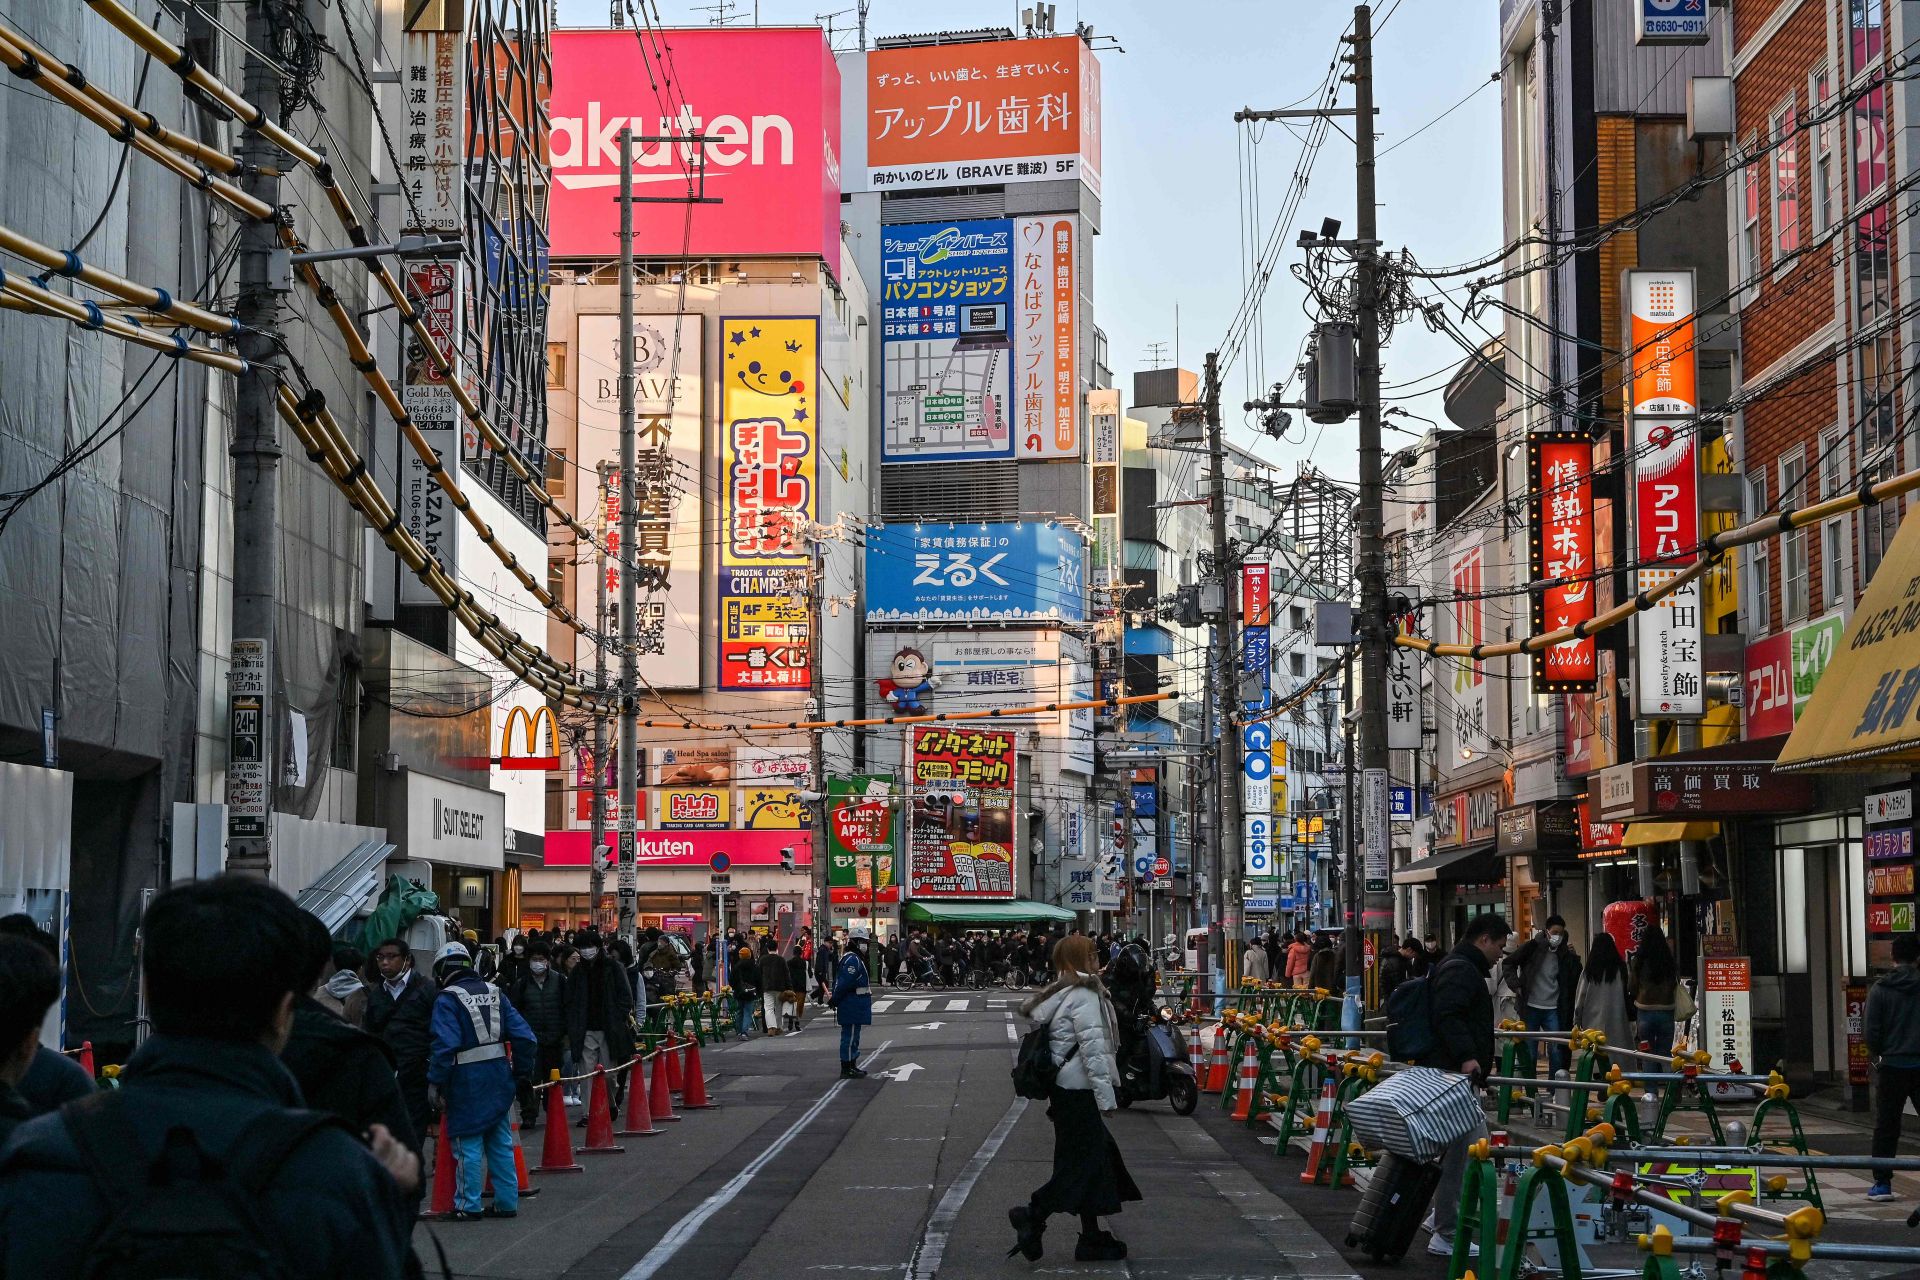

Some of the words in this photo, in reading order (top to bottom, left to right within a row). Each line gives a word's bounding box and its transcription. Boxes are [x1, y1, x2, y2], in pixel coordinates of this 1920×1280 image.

[1655, 20, 1703, 32] 6630-0911
[874, 91, 1072, 141] アップル歯科
[549, 101, 793, 168] akuten
[1055, 159, 1076, 173] 5F
[407, 209, 426, 218] TEL
[406, 219, 455, 228] 632-3319
[918, 266, 1007, 279] アウトレット・リユース
[885, 276, 1008, 300] パソコンショップ
[1024, 252, 1045, 432] なんばアップル歯科
[1056, 229, 1070, 442] 難波・梅田・尼崎・三宮・明石・加古川
[1656, 330, 1672, 393] 松田宝飾
[406, 388, 430, 398] Gold
[406, 405, 452, 414] 06-6643
[415, 413, 443, 421] 6666
[436, 422, 448, 430] 5F
[1654, 484, 1681, 558] アコム
[914, 536, 1009, 549] 「家賃債務保証」の
[731, 569, 763, 577] TRADING
[912, 552, 1011, 588] えるく
[730, 577, 808, 594] CHAMPIN
[1251, 575, 1261, 624] ホットヨガ
[742, 604, 762, 616] 4F
[774, 611, 808, 619] スペース
[729, 605, 738, 634] 当ビル
[742, 625, 761, 636] 3F
[727, 648, 808, 668] 一番くじ
[1257, 638, 1267, 666] マシン
[1660, 629, 1668, 697] jewelry&watch
[737, 670, 802, 683] 大量入荷!!
[967, 670, 1020, 686] 賃貸住宅
[1749, 660, 1789, 718] アコム
[235, 711, 256, 733] 24H
[916, 731, 1009, 755] インターネット
[698, 750, 710, 758] Spa
[919, 763, 931, 777] 24
[955, 760, 1008, 782] コミック
[926, 779, 966, 788] 歩車分離式
[1653, 774, 1761, 791] 高価買取
[673, 796, 716, 811] トレカ
[673, 809, 716, 818] チャンピオン
[838, 809, 884, 822] CANDY
[443, 806, 459, 836] SUIT
[460, 808, 484, 841] SELECT
[636, 837, 694, 856] kuten
[851, 837, 872, 846] SHOP
[1251, 819, 1266, 870] GiGO
[1070, 870, 1093, 883] 賃貸
[1070, 891, 1093, 904] 売買
[833, 906, 856, 914] CANDY
[1721, 1008, 1736, 1066] 松田宝飾
